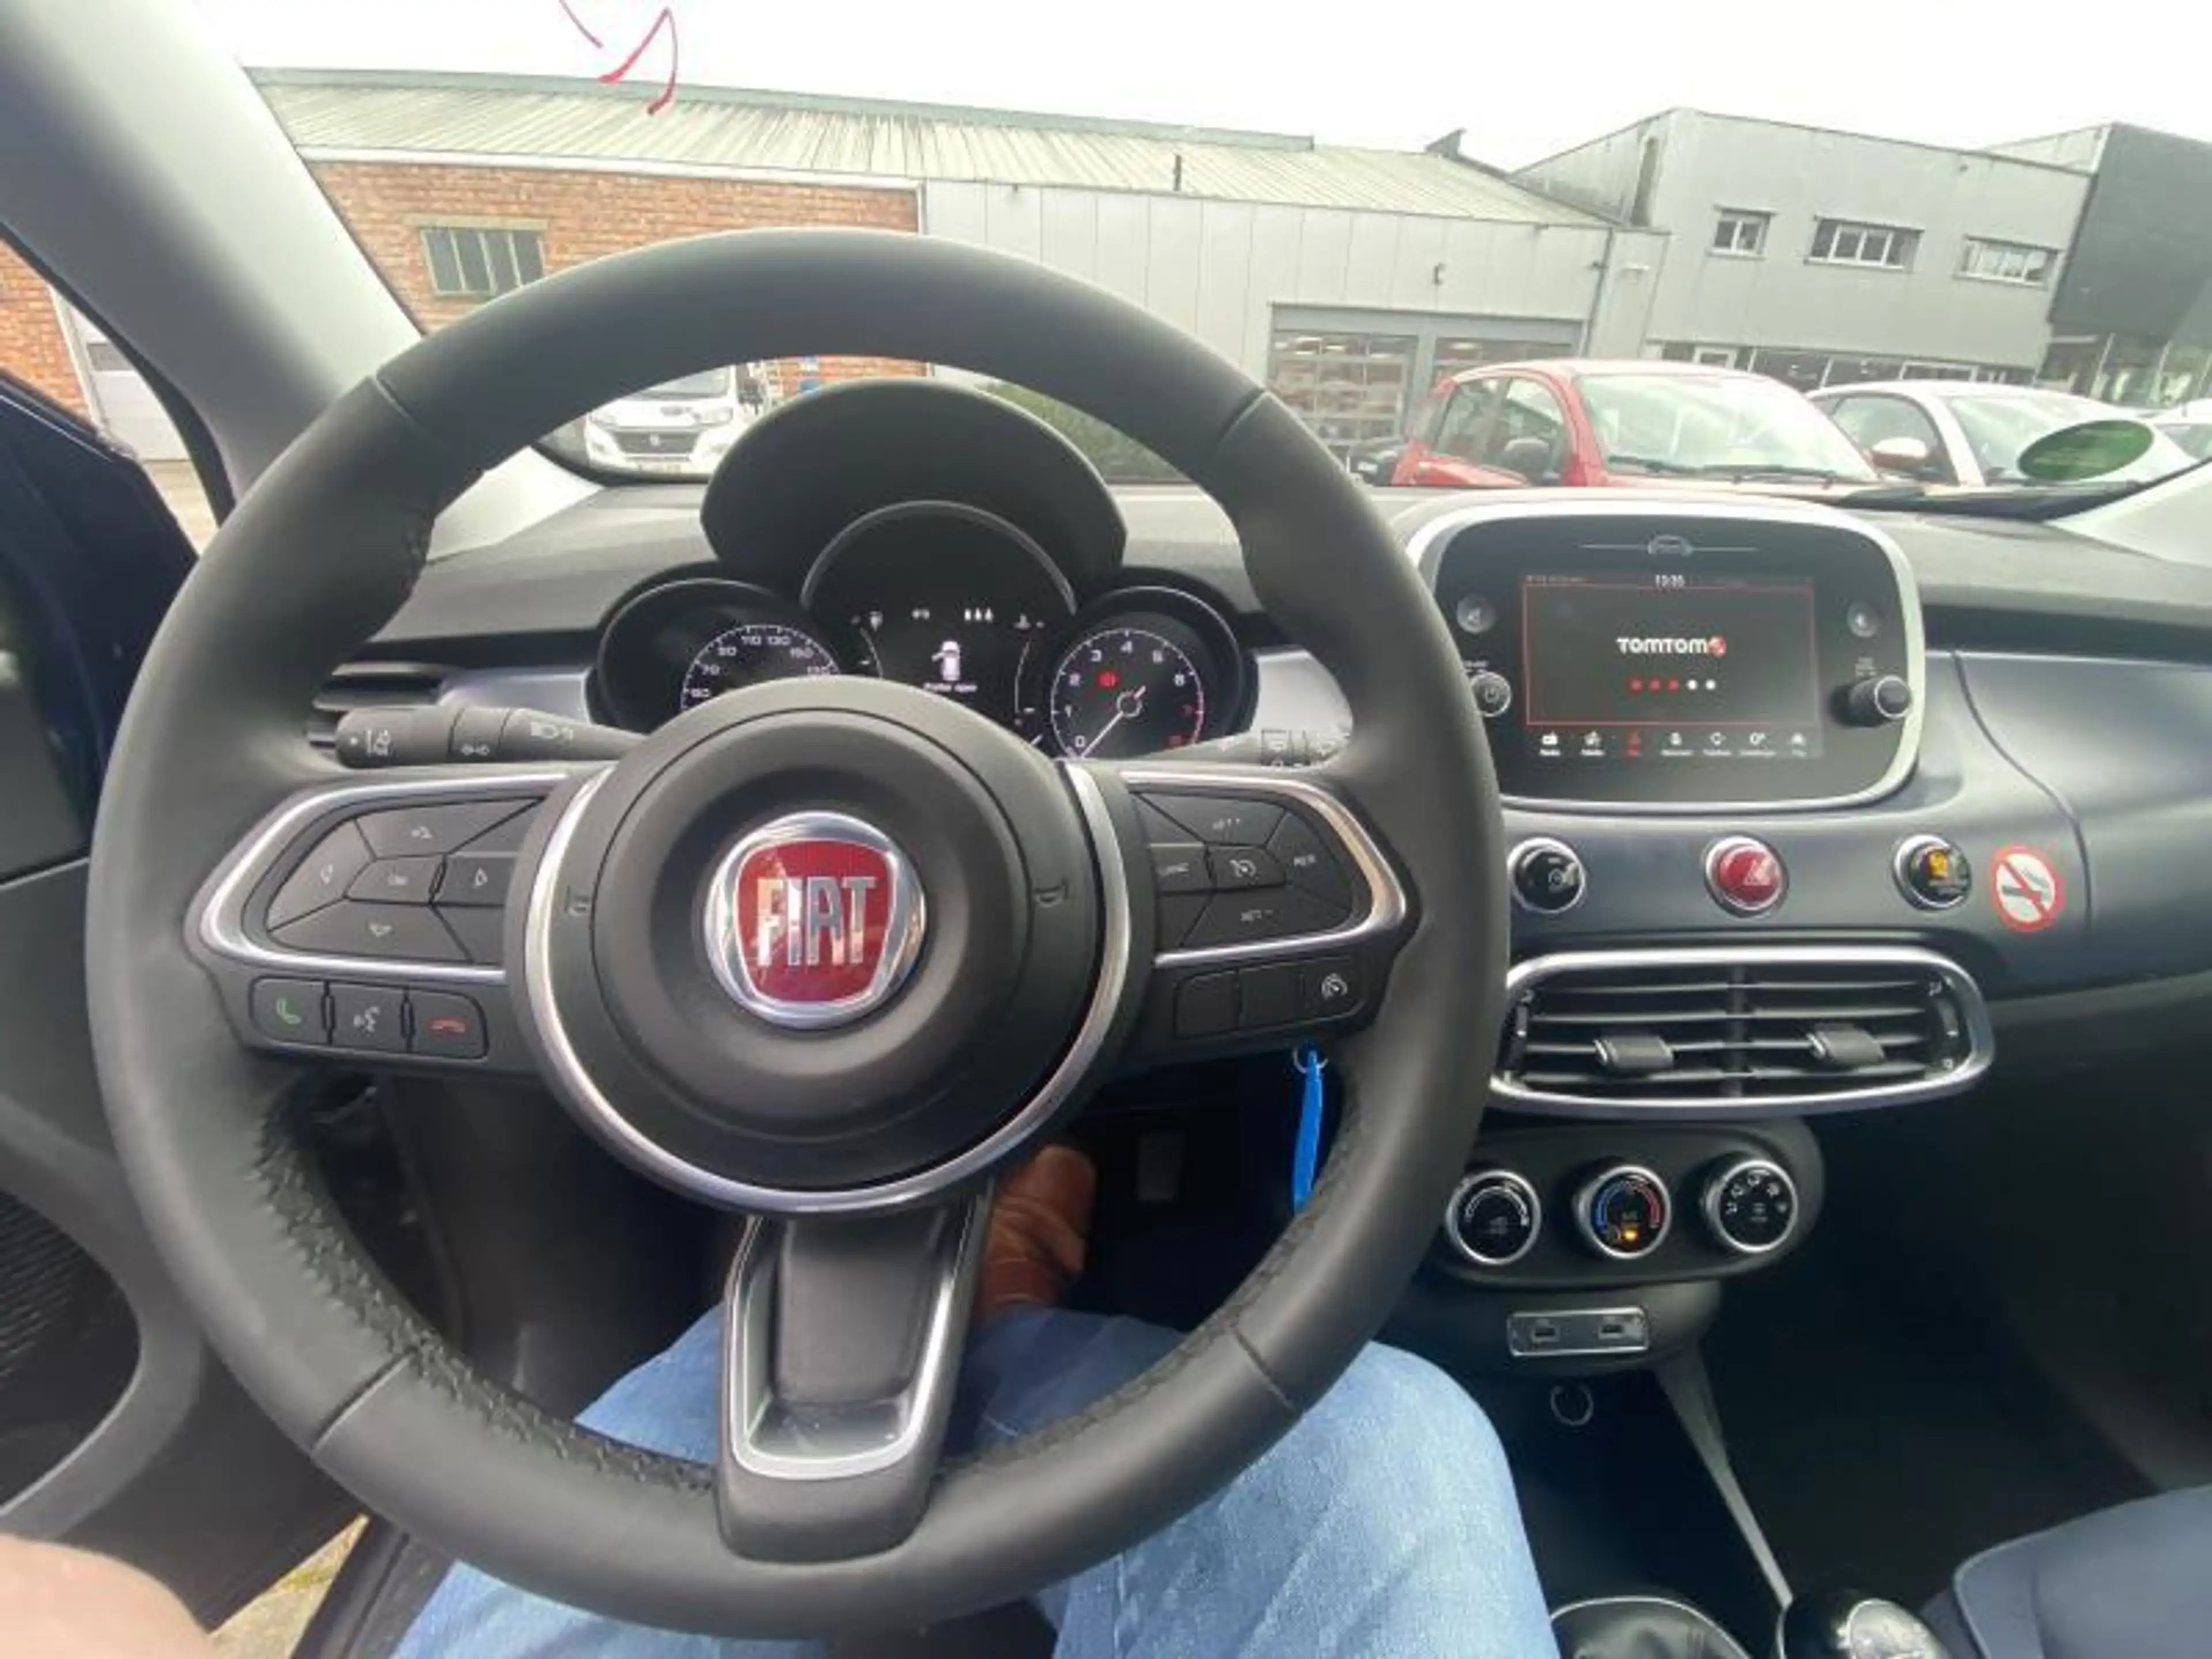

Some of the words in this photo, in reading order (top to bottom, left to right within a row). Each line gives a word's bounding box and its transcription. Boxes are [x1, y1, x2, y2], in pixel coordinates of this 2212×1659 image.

[741, 635, 762, 645] 110
[1120, 641, 1132, 653] 4
[1090, 649, 1103, 662] 3
[1074, 735, 1086, 748] 0
[757, 876, 878, 967] FIAT
